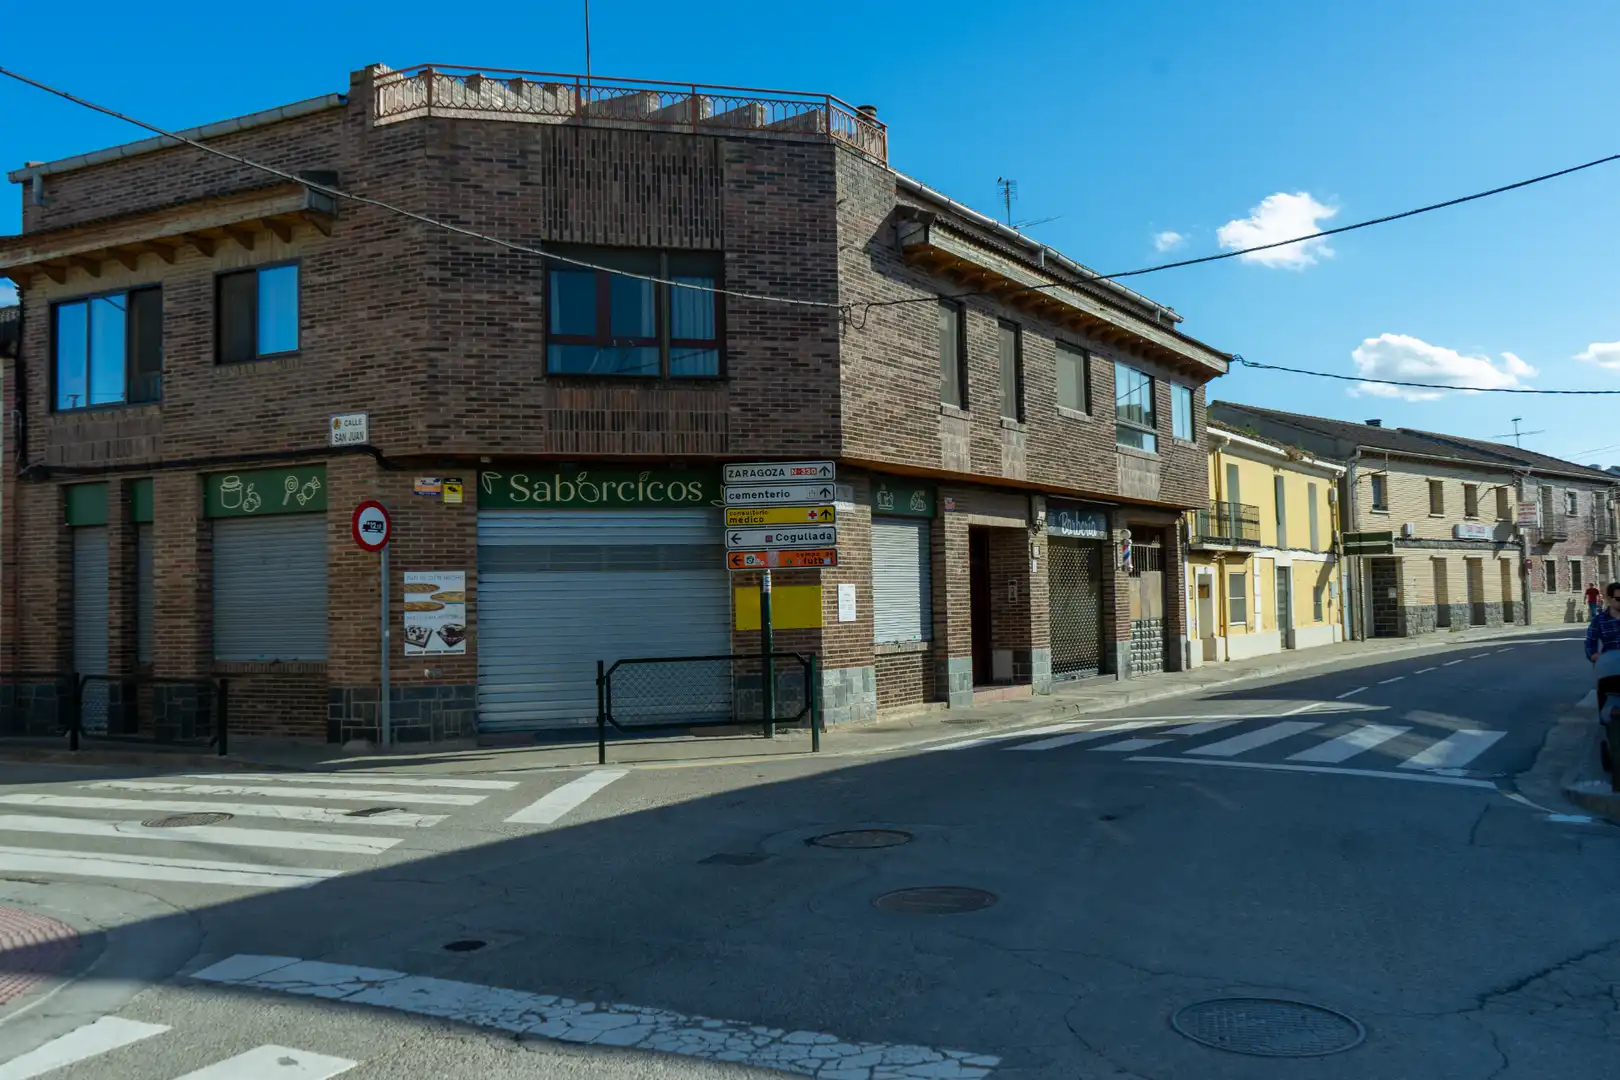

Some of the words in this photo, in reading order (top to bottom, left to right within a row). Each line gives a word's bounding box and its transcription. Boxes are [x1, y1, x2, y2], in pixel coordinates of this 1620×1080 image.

[343, 418, 363, 427] CALLE
[334, 432, 347, 443] SAN
[347, 430, 364, 442] JUAN
[728, 468, 786, 478] ZARAGOZA
[791, 467, 816, 476] N-330
[509, 472, 703, 503] Saborcicos
[728, 489, 790, 500] cementerio
[1058, 511, 1097, 537] Barbería
[775, 532, 832, 543] Cogullada
